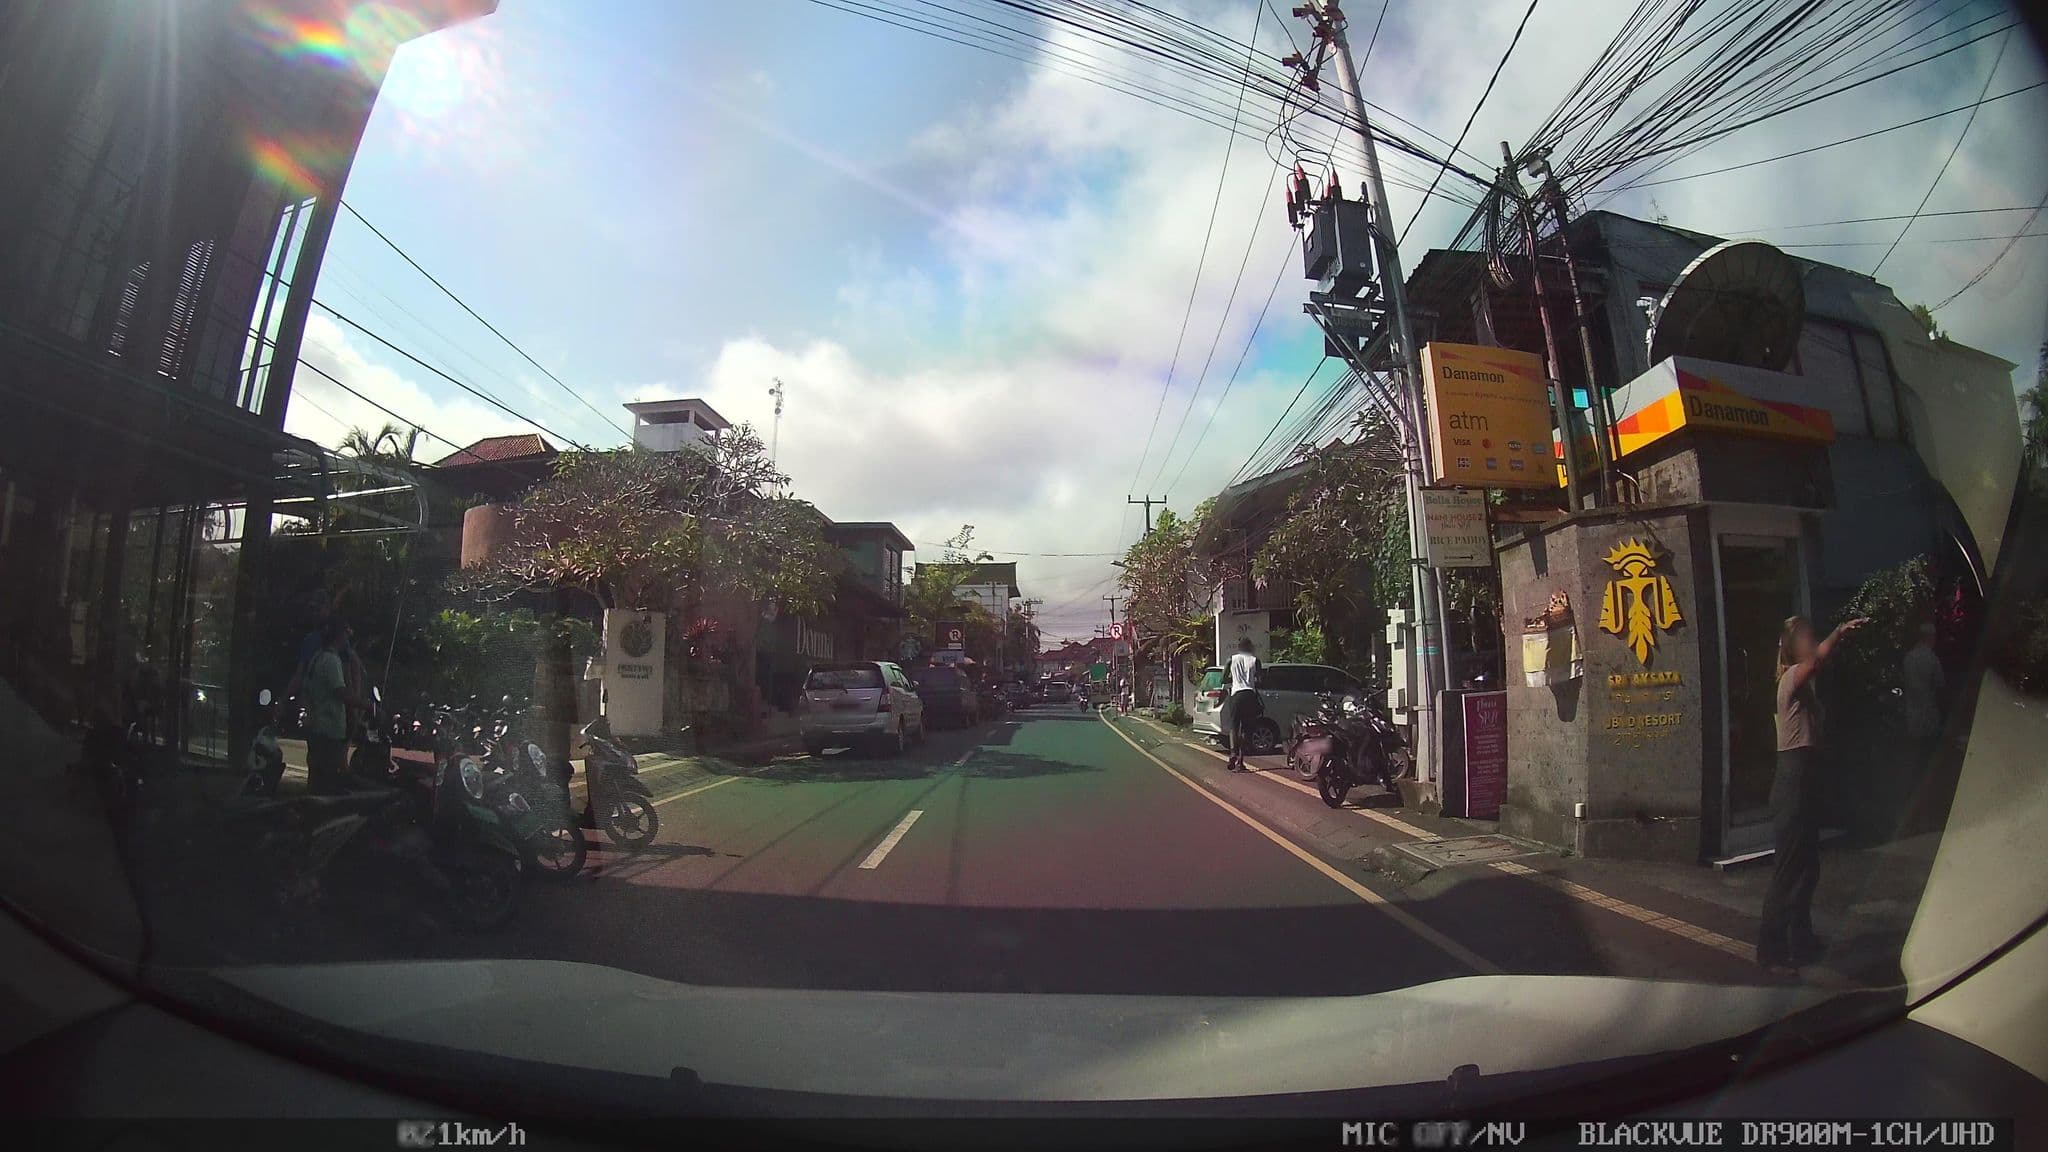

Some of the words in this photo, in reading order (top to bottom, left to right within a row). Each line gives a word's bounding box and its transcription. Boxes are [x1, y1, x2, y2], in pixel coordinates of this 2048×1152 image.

[1442, 366, 1505, 384] Danamon
[1688, 394, 1769, 425] Danamon
[1449, 411, 1489, 431] atm
[1453, 438, 1472, 446] VISA
[1430, 535, 1454, 545] RICE
[1455, 535, 1487, 545] PADDY
[952, 630, 960, 640] R
[1114, 626, 1121, 635] R
[1606, 716, 1636, 730] BD
